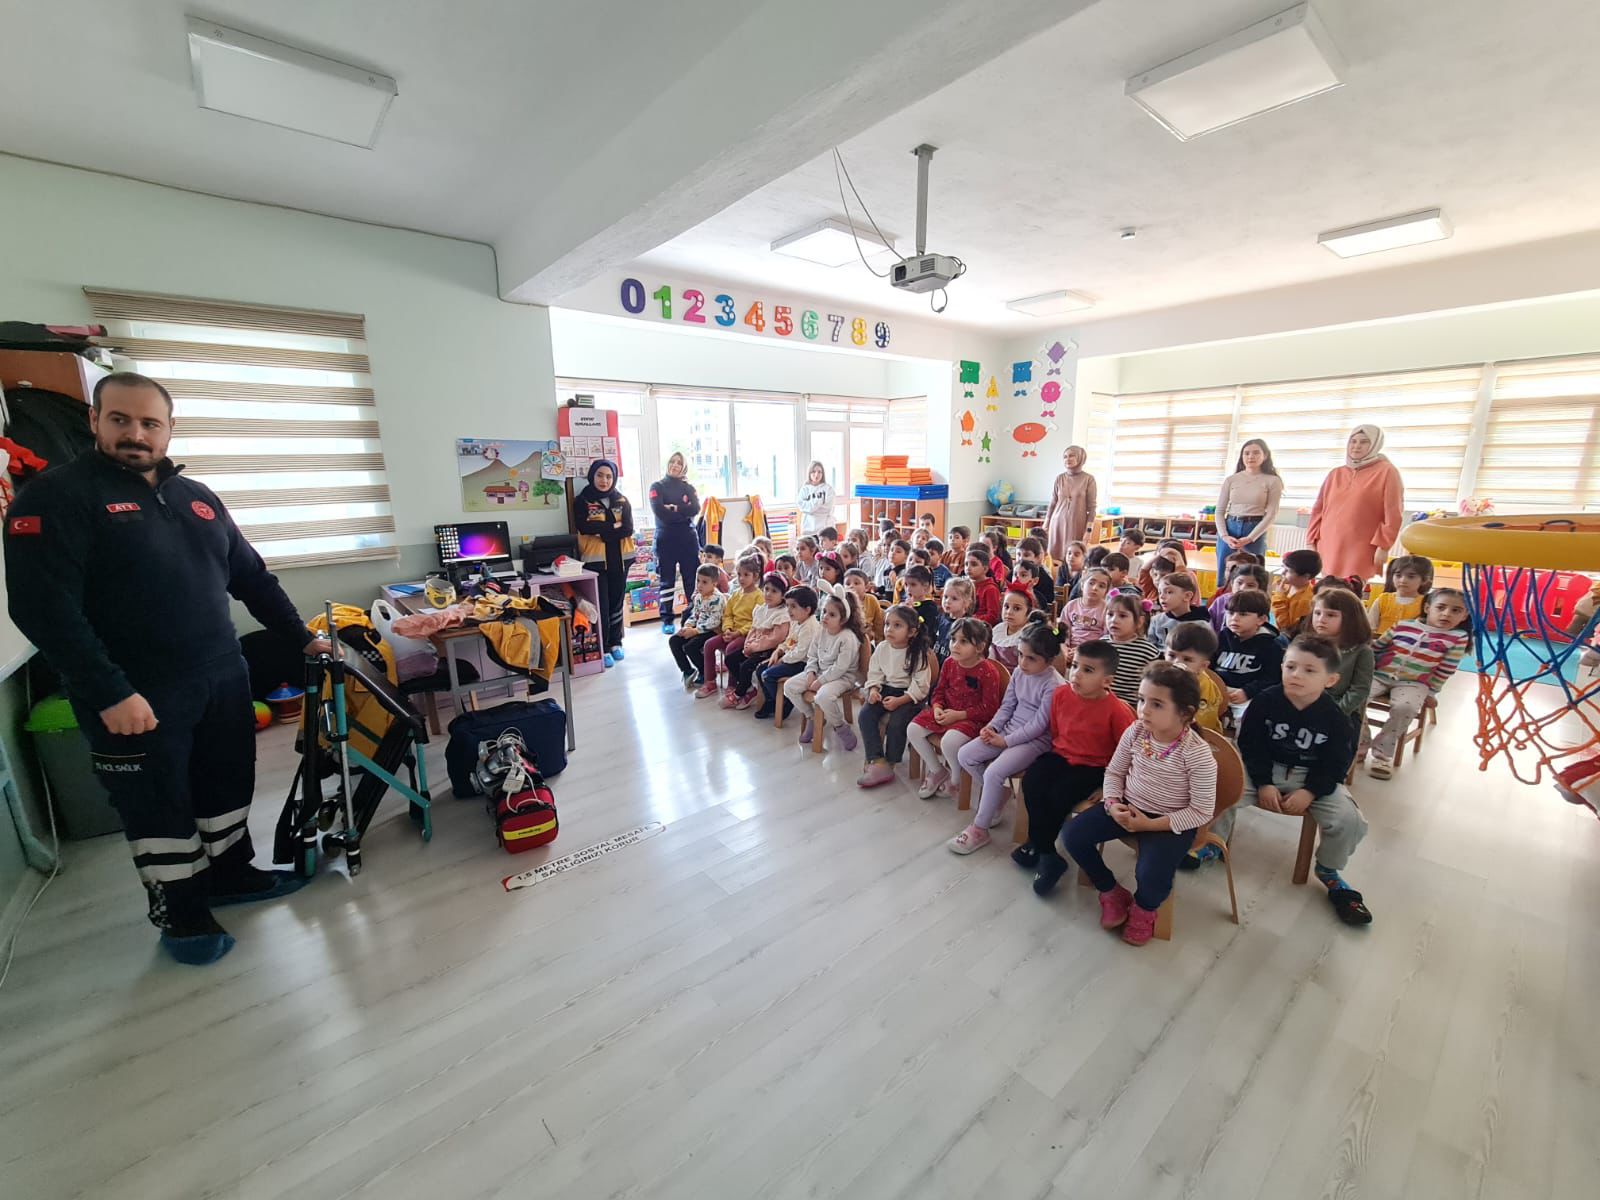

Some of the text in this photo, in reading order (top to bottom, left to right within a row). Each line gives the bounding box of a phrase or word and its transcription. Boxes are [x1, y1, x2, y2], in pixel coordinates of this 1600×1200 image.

[620, 278, 891, 348] 0 1 2 3 4 5 6 7 8 9
[1216, 651, 1256, 670] NIKE
[534, 856, 572, 874] METRE
[572, 841, 612, 859] SOSYAL
[604, 836, 640, 853] KORUR
